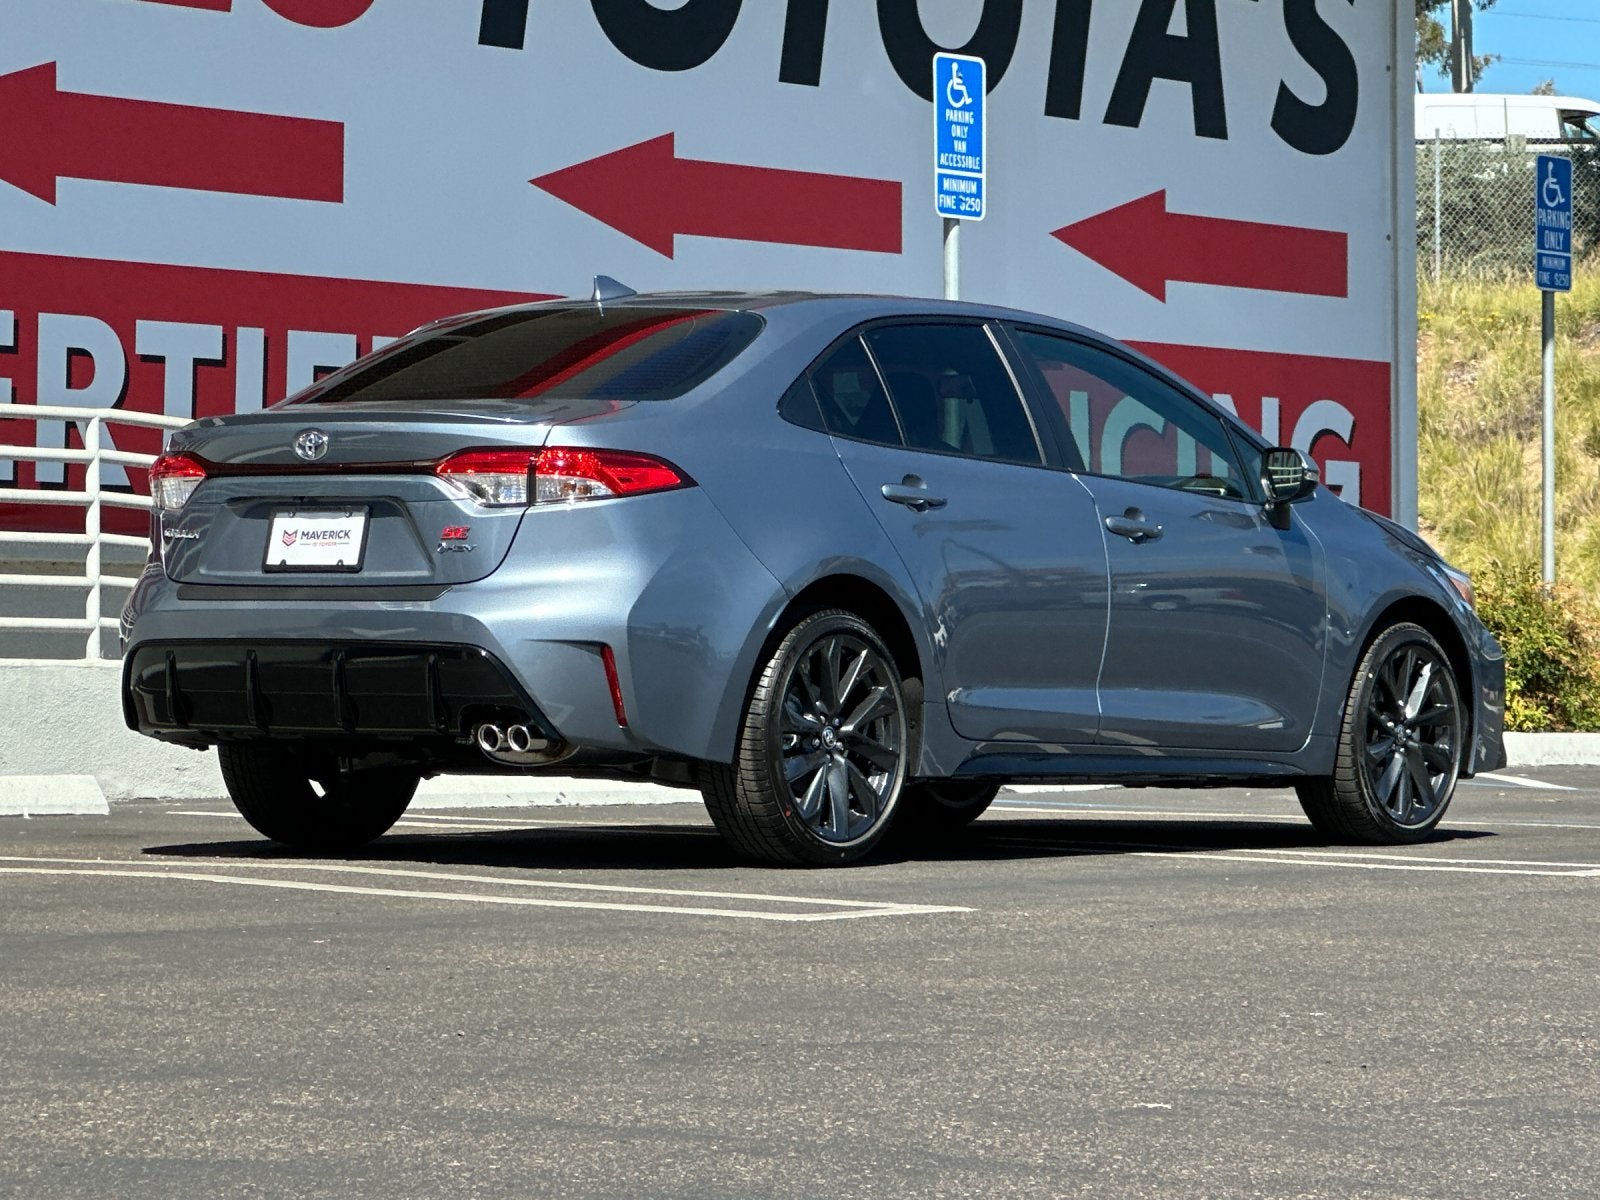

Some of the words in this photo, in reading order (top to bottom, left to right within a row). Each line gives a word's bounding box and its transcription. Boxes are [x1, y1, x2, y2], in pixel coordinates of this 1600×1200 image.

[946, 109, 974, 124] PARKING
[952, 125, 968, 138] ONLY
[954, 140, 966, 152] VAN
[940, 153, 980, 169] ACCESSIBLE
[944, 178, 977, 193] MINIMUM
[940, 194, 956, 209] FINE
[1538, 208, 1570, 229] PARKING
[1544, 230, 1564, 250] ONLY
[1538, 271, 1550, 284] FINE
[1554, 272, 1569, 286] $250
[300, 529, 352, 540] MAVERICK
